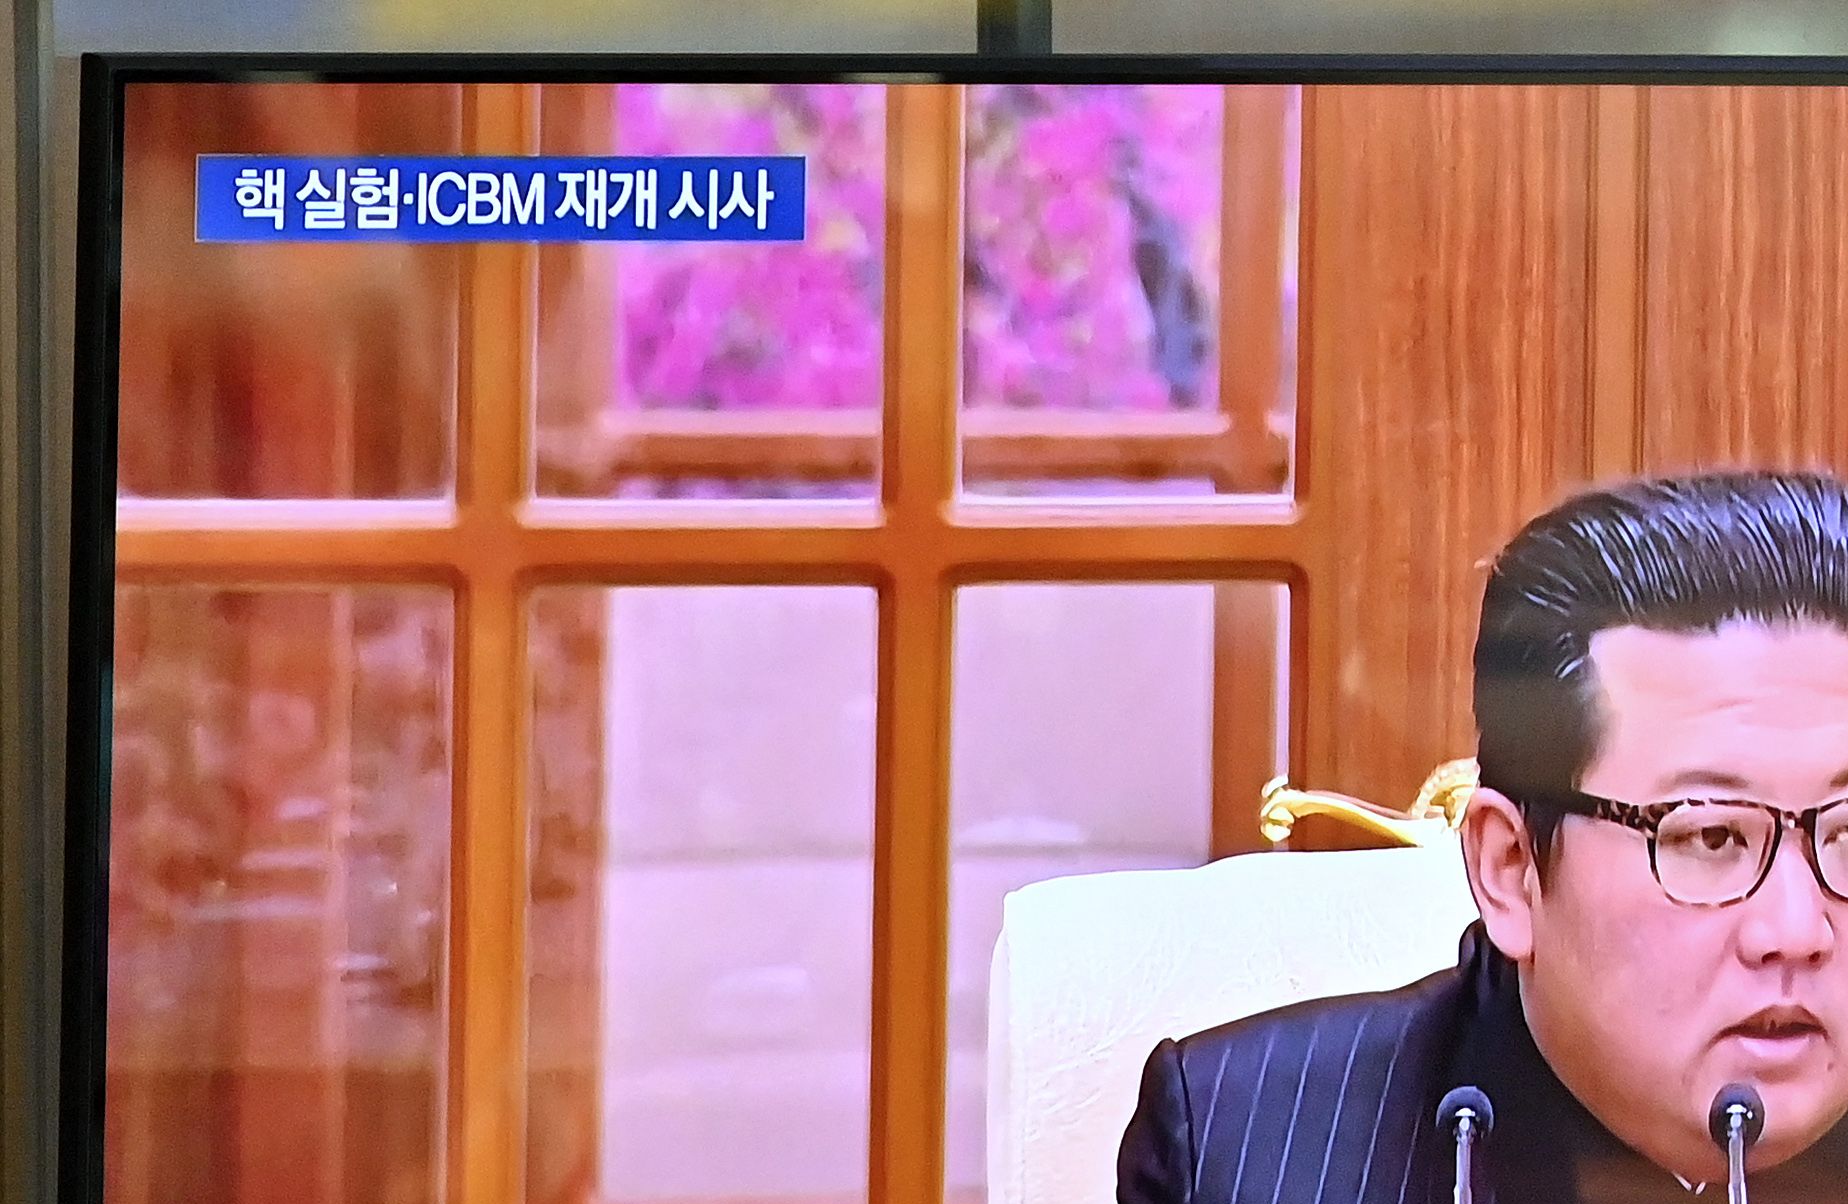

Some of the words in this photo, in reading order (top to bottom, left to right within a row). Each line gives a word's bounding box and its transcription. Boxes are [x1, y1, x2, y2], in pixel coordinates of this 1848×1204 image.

[234, 167, 285, 230] 핵
[554, 168, 656, 229] 재개
[668, 168, 774, 230] 시사
